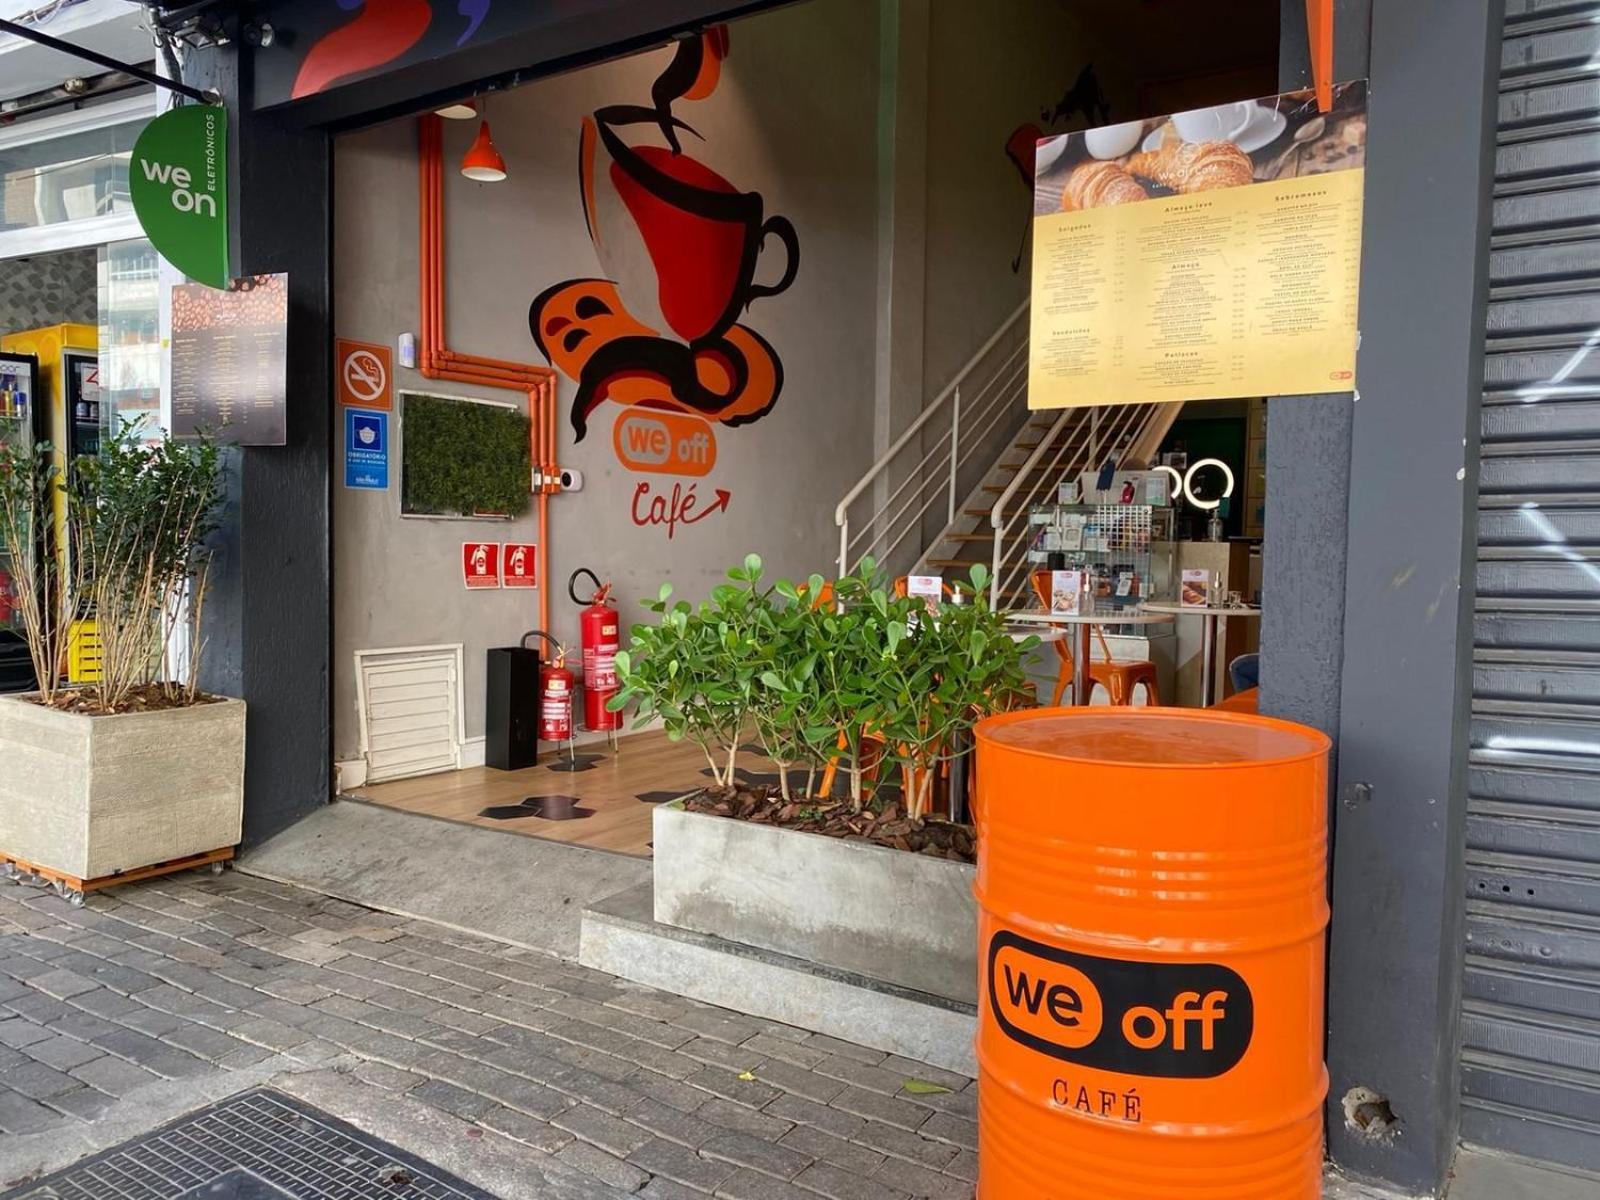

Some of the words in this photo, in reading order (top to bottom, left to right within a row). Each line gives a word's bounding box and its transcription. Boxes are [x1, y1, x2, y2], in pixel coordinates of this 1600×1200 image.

[140, 158, 192, 188] we
[171, 188, 217, 217] on
[677, 430, 709, 464] off
[631, 481, 698, 540] Café
[1003, 963, 1084, 1027] we
[1120, 990, 1229, 1050] off
[1051, 1078, 1142, 1123] CAFÉ
